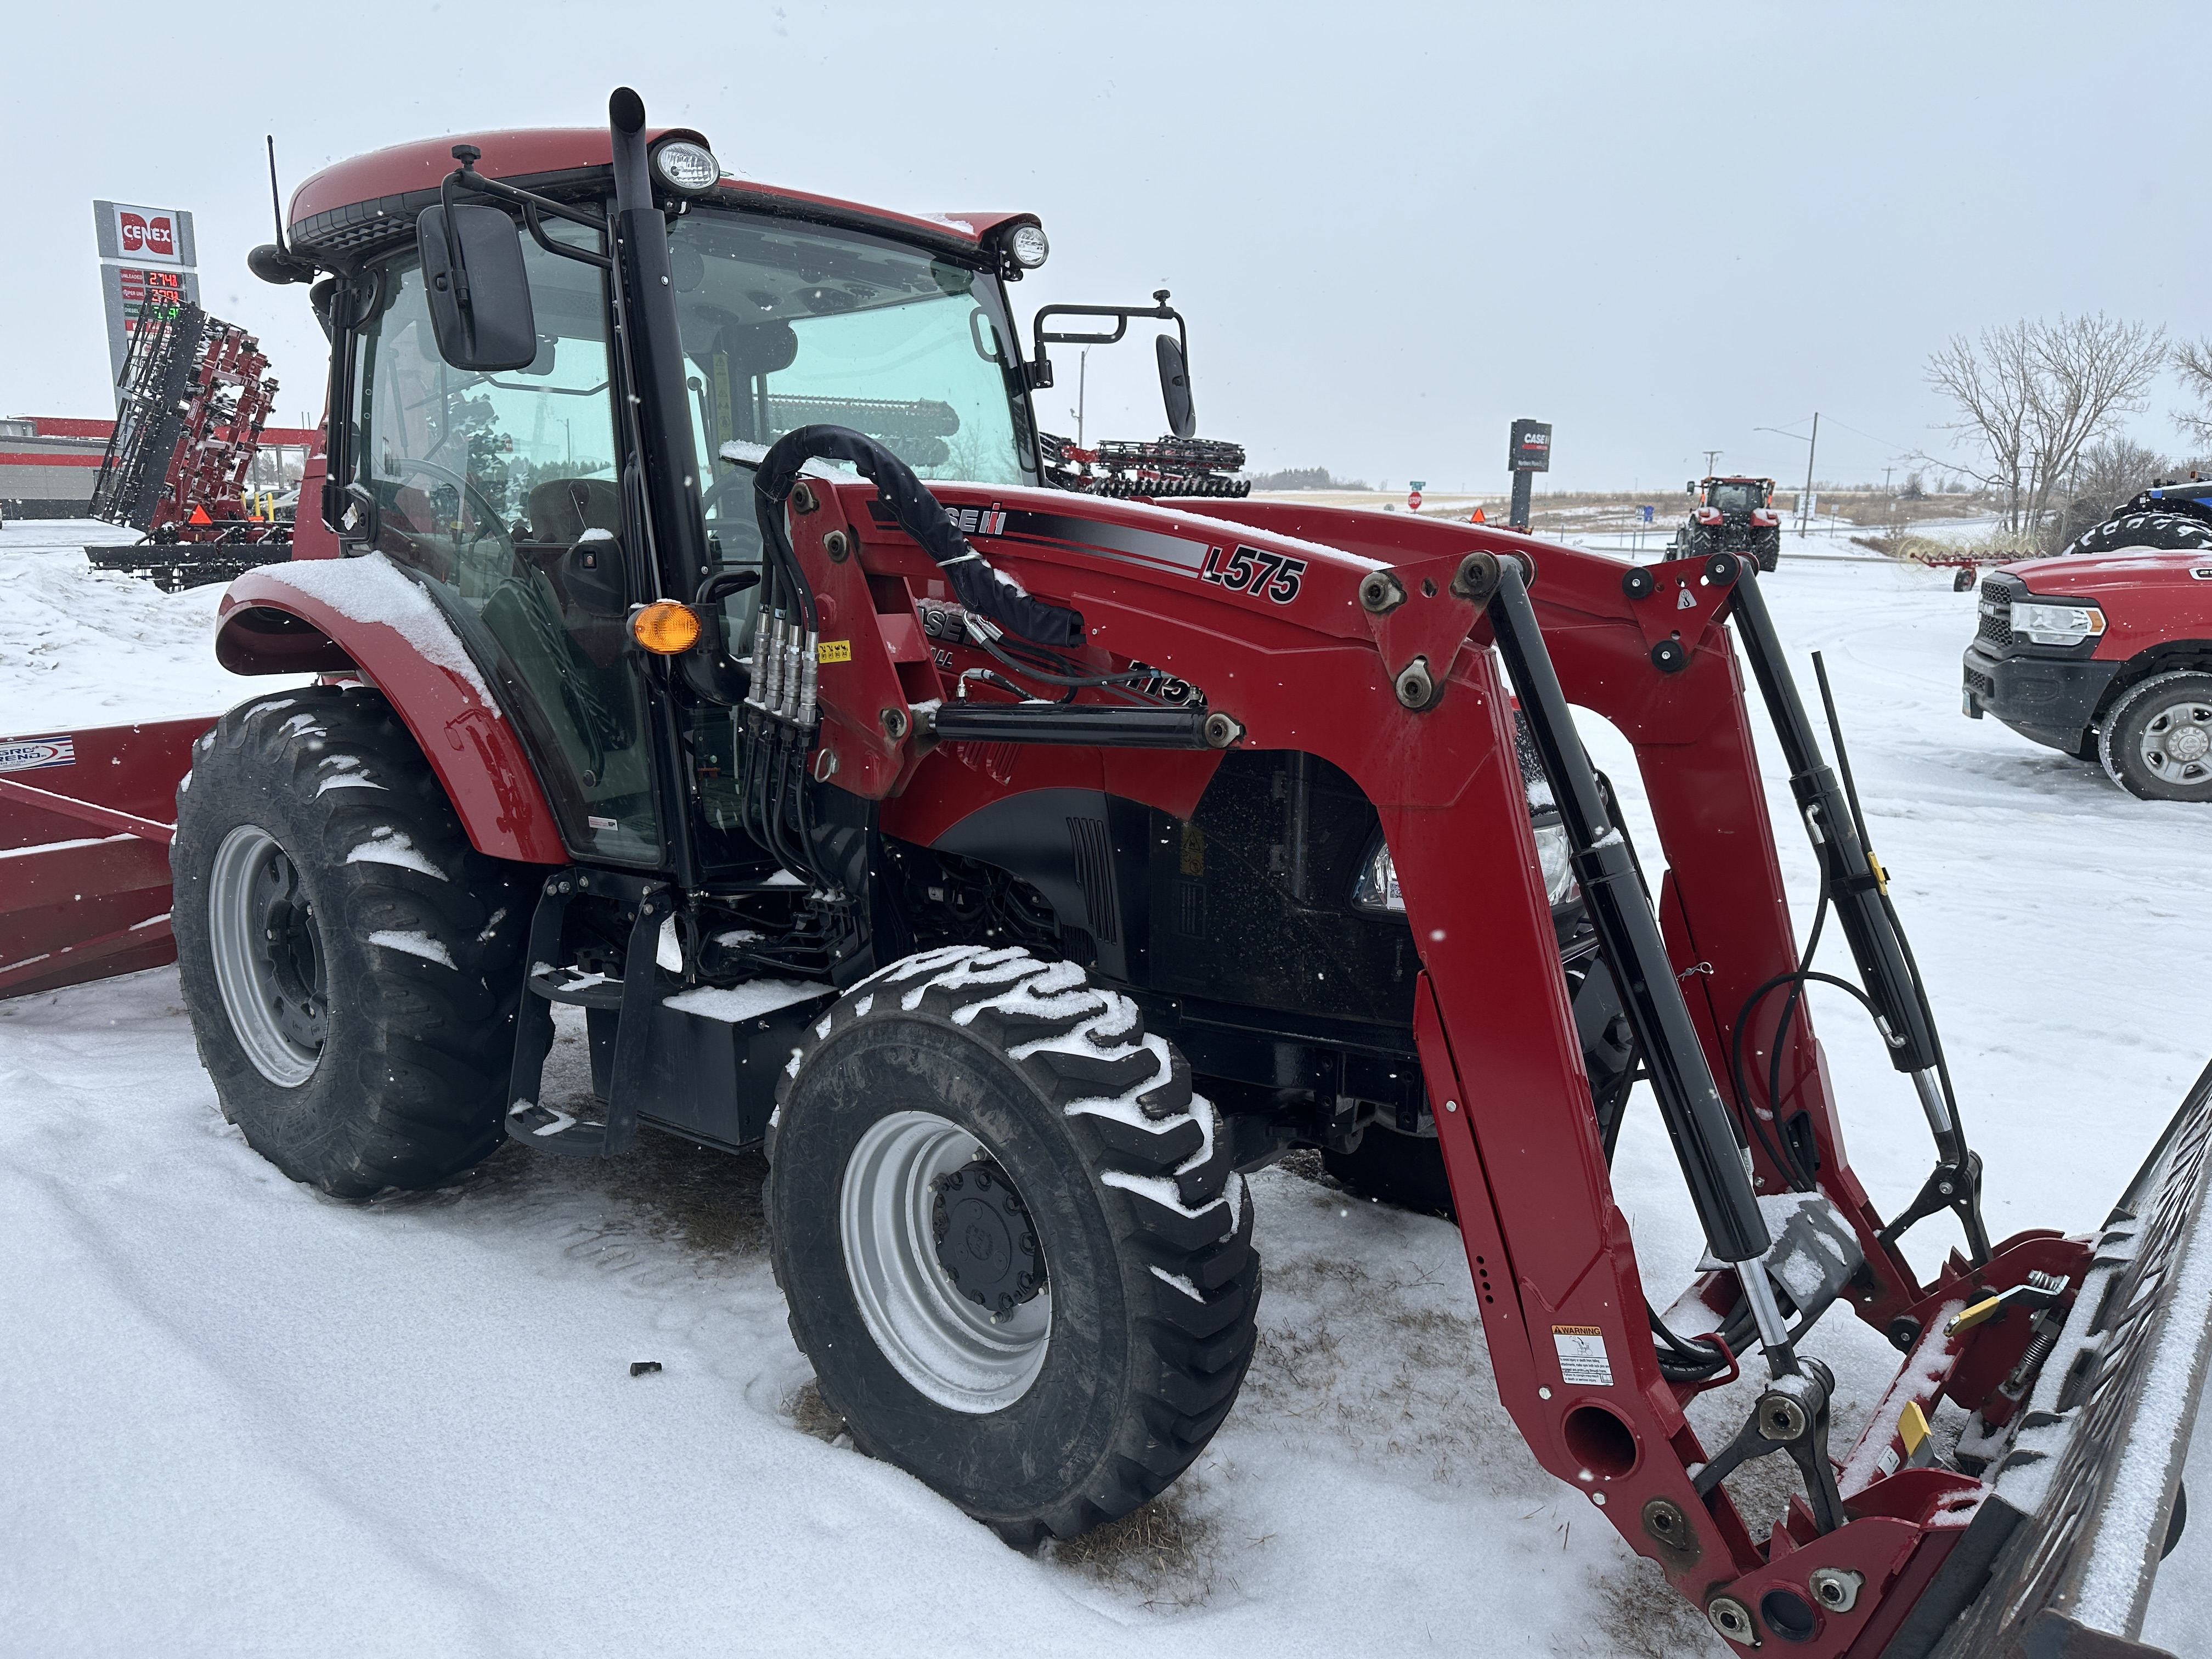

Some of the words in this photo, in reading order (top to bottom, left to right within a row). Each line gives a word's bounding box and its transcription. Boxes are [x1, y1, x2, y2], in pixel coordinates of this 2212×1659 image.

[123, 225, 171, 242] CENEX
[1524, 433, 1545, 444] CASE
[1201, 544, 1308, 604] L575
